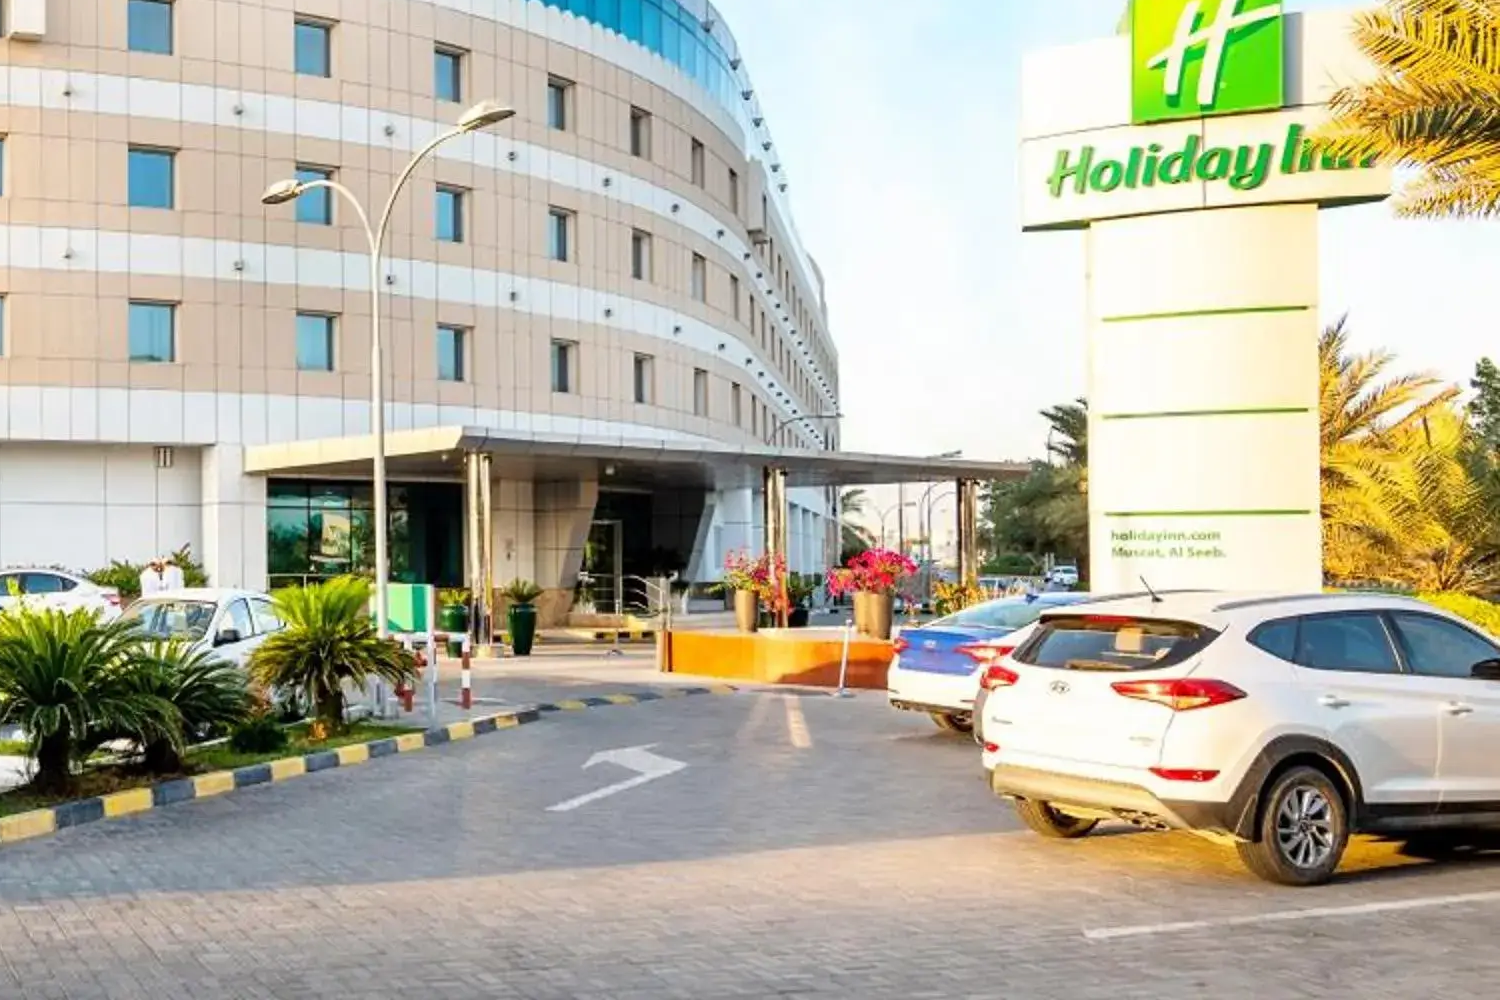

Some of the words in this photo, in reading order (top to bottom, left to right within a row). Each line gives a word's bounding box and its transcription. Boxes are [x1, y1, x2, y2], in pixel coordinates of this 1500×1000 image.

[1047, 134, 1274, 198] Holiday
[1111, 530, 1221, 543] holidayinn.com
[1169, 547, 1183, 558] Al
